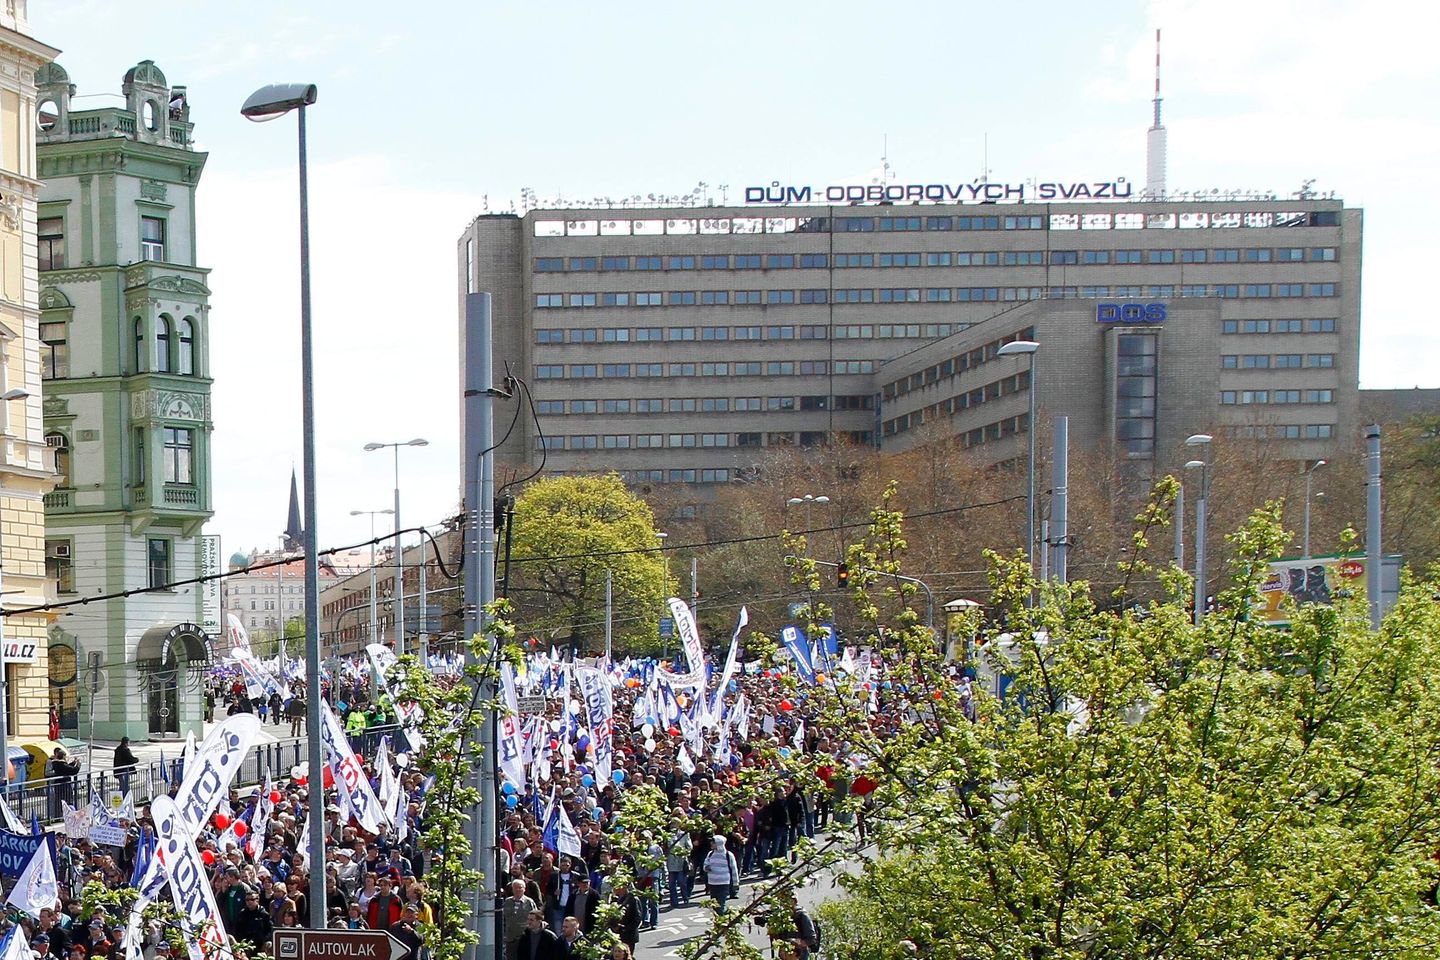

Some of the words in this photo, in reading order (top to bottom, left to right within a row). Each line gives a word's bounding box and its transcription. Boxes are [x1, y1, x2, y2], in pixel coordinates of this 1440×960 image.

[745, 180, 812, 203] DŮM
[826, 178, 1025, 201] ODBOROVÝCH
[1039, 177, 1133, 199] SVAZŮ
[1095, 303, 1168, 323] DOS
[308, 942, 376, 957] AUTOVLAK
